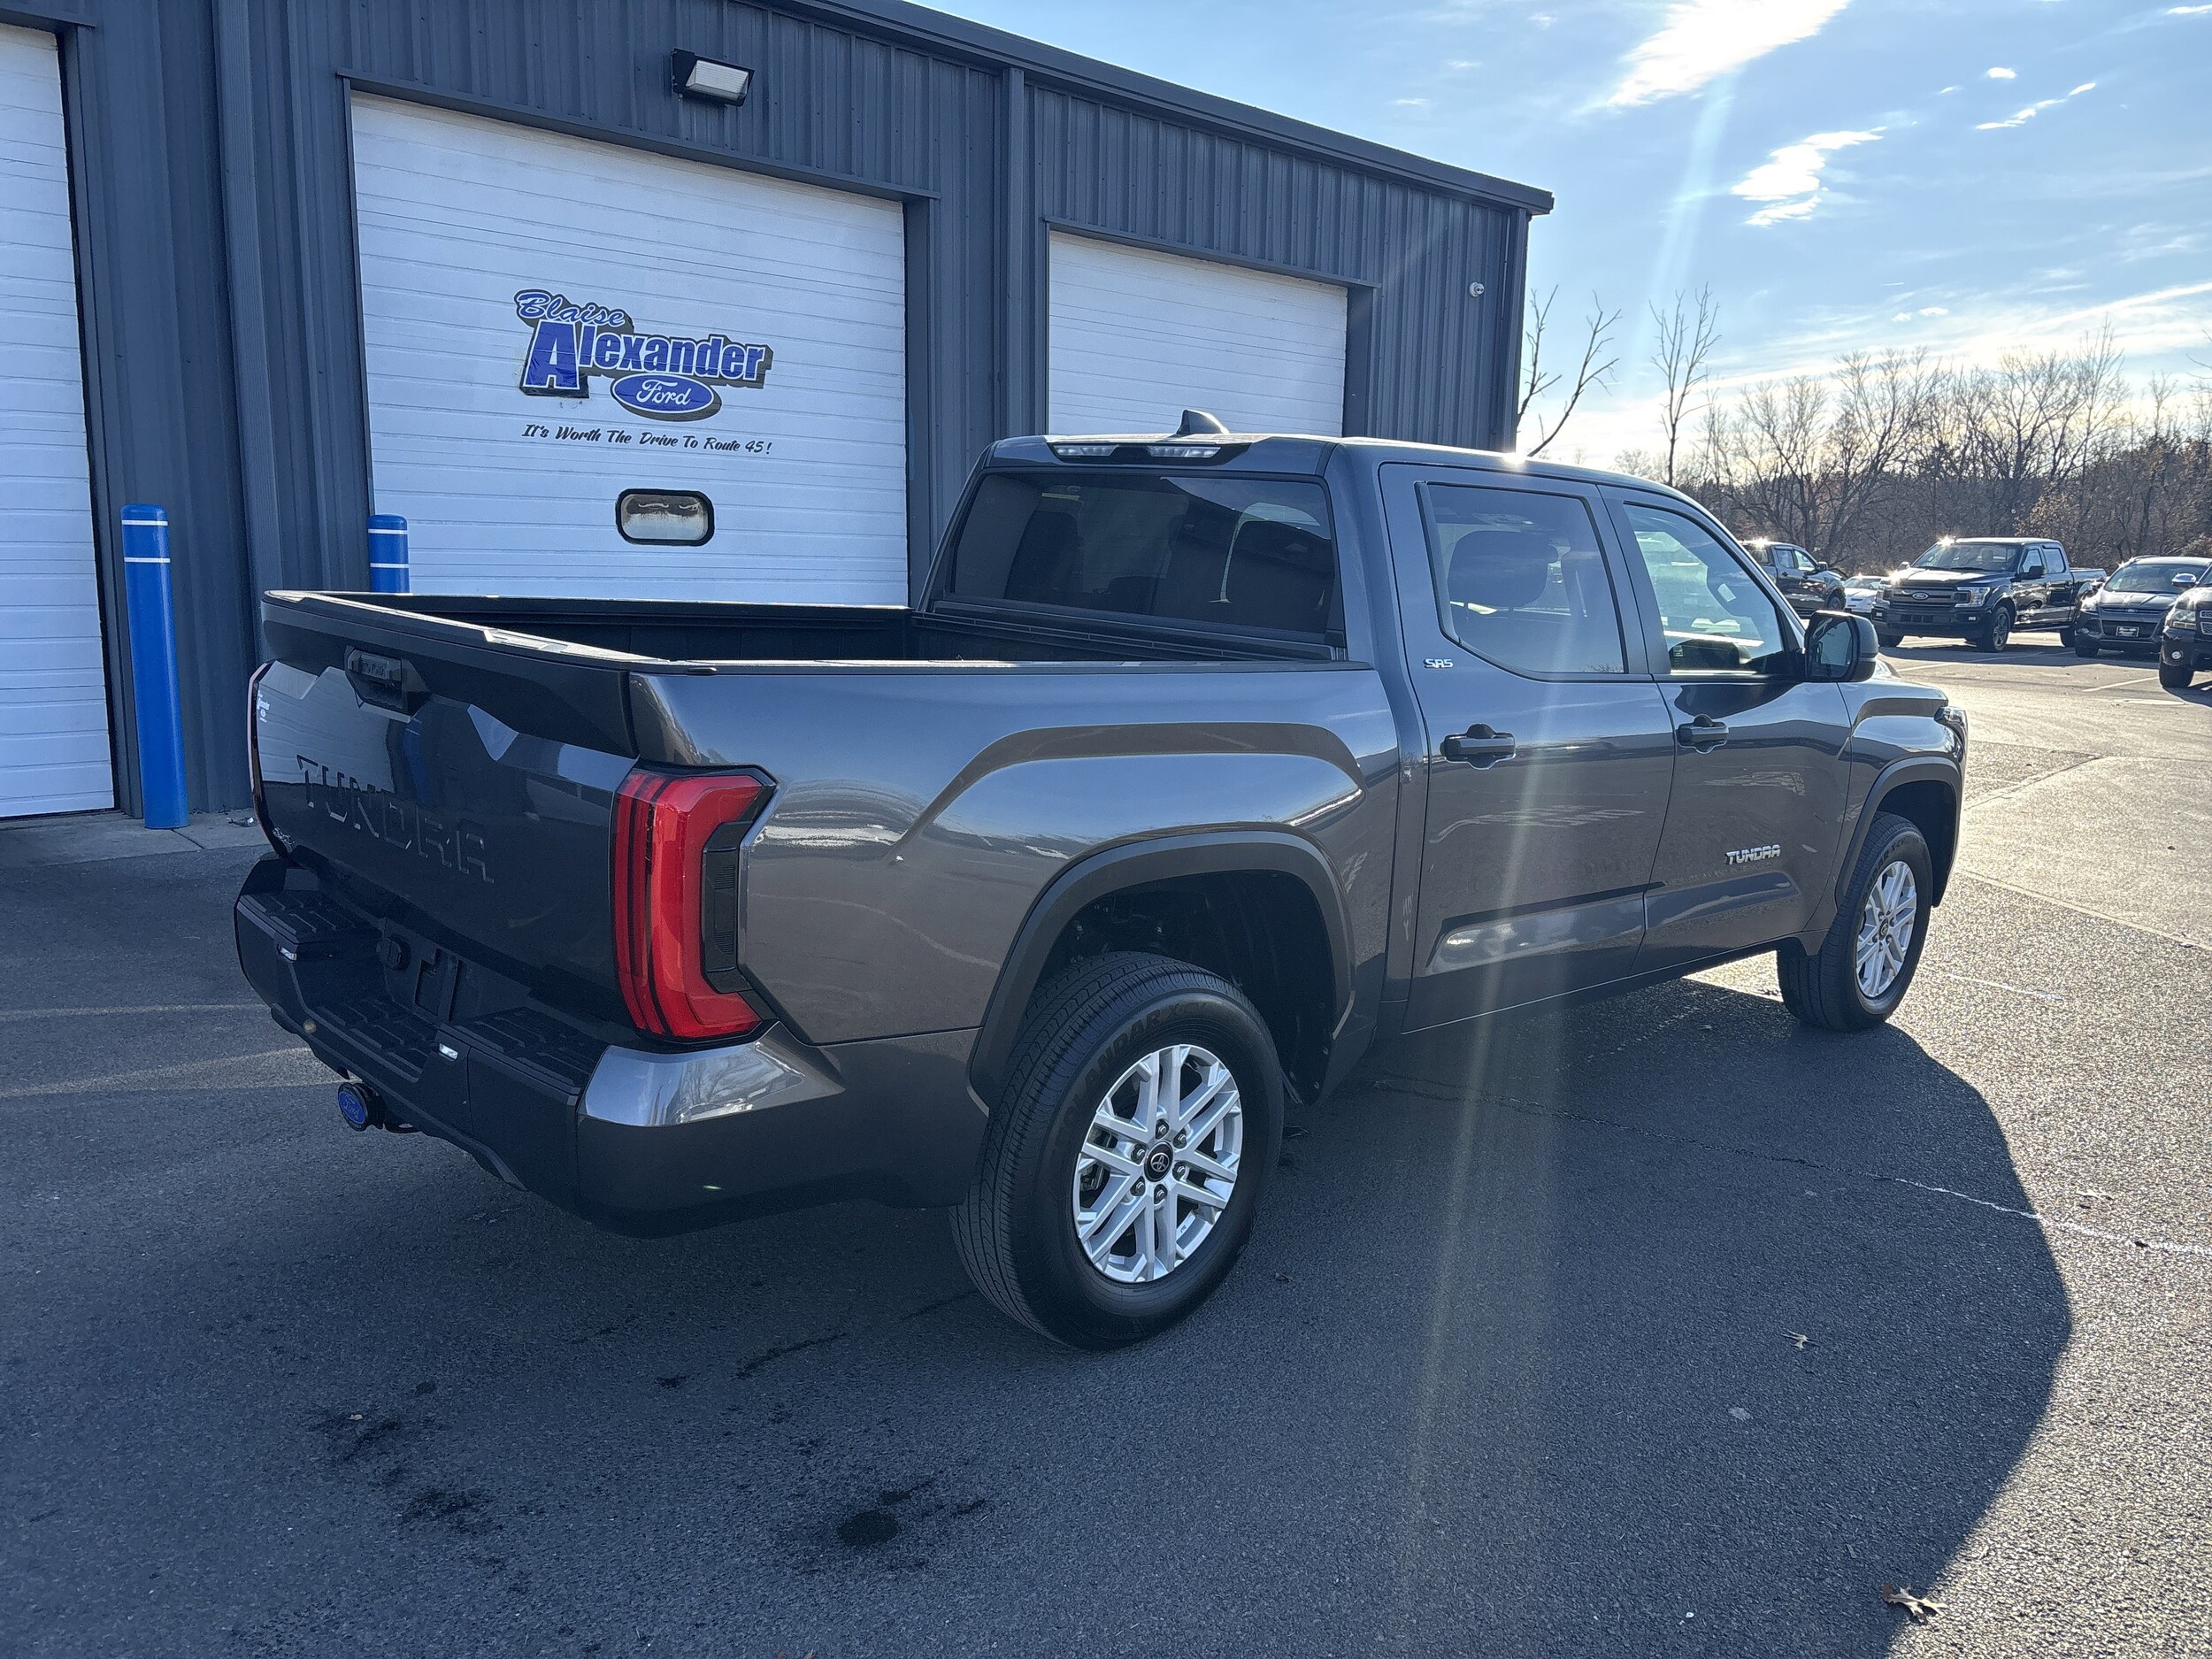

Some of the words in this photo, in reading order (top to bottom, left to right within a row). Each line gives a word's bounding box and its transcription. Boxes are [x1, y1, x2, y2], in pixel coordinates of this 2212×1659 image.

[518, 290, 626, 326] Blaise
[522, 319, 766, 391] Alexander
[635, 379, 692, 406] Ford
[521, 424, 549, 438] It's
[555, 426, 602, 442] Worth
[607, 430, 632, 444] The
[639, 432, 679, 447] Drive
[682, 435, 699, 449] To
[703, 437, 741, 451] Route
[1424, 658, 1454, 668] SR5
[296, 754, 495, 884] TUNDRA
[1725, 844, 1781, 864] TUNDRA
